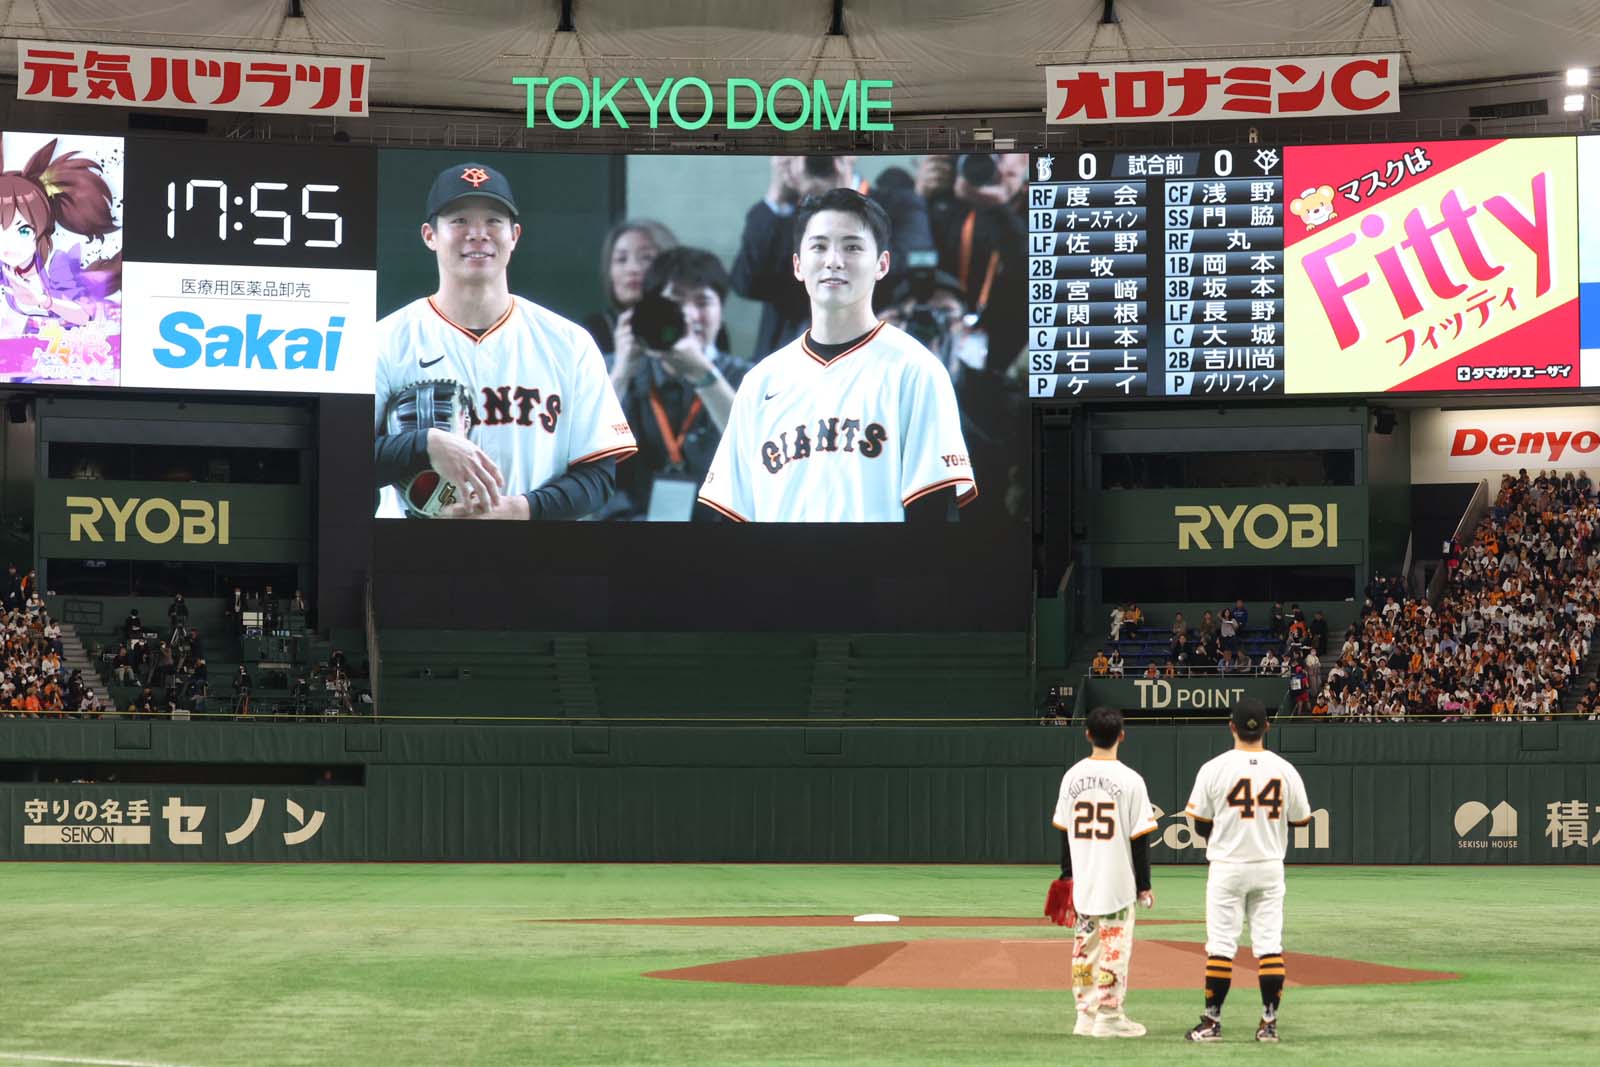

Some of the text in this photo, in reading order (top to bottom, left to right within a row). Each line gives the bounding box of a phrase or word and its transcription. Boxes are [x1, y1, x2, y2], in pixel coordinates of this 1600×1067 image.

[24, 49, 365, 113] 元気ハツラツ!
[1056, 59, 1391, 120] オロナミンC
[512, 76, 894, 131] TOKYO DOME
[1079, 153, 1097, 180] 0
[1128, 154, 1184, 175] 試合前
[1214, 149, 1233, 177] 0
[1338, 147, 1433, 204] マスクは
[1032, 189, 1052, 206] RF
[1168, 186, 1189, 203] CF
[167, 179, 343, 248] 17:55
[1033, 210, 1138, 229] 1B オースティン
[1168, 209, 1189, 226] SS
[1033, 236, 1052, 253] LF
[1168, 229, 1251, 250] RF 丸
[1032, 256, 1114, 277] 2B 牧
[1169, 256, 1189, 274] 1B
[1301, 171, 1552, 351] Fitty
[181, 278, 311, 298] 医療用医薬品卸売
[1032, 283, 1053, 300] 3B
[1168, 280, 1189, 297] 3B
[1032, 307, 1052, 324] CF
[1170, 304, 1188, 321] LF
[1173, 328, 1184, 345] C
[1385, 287, 1518, 367] フィッティ
[153, 311, 346, 371] Sakai
[1037, 330, 1048, 347] C
[1032, 354, 1053, 371] SS
[1169, 348, 1275, 369] 2B 吉川尚
[1174, 373, 1275, 393] P グリフィン
[1471, 365, 1572, 380] タマガワエーザイ
[1037, 378, 1048, 395] P
[761, 417, 888, 475] GIANTS
[1450, 429, 1600, 462] Denyo
[66, 496, 230, 545] RYOBI
[1174, 503, 1338, 550] RYOBI
[1134, 679, 1245, 709] TD POINT
[1226, 778, 1283, 819] 44
[24, 798, 151, 824] 守りの名手
[162, 797, 326, 845] セノン
[1073, 800, 1116, 841] 25
[61, 826, 114, 843] SENON
[1458, 840, 1518, 848] SEKISUI HOUSE
